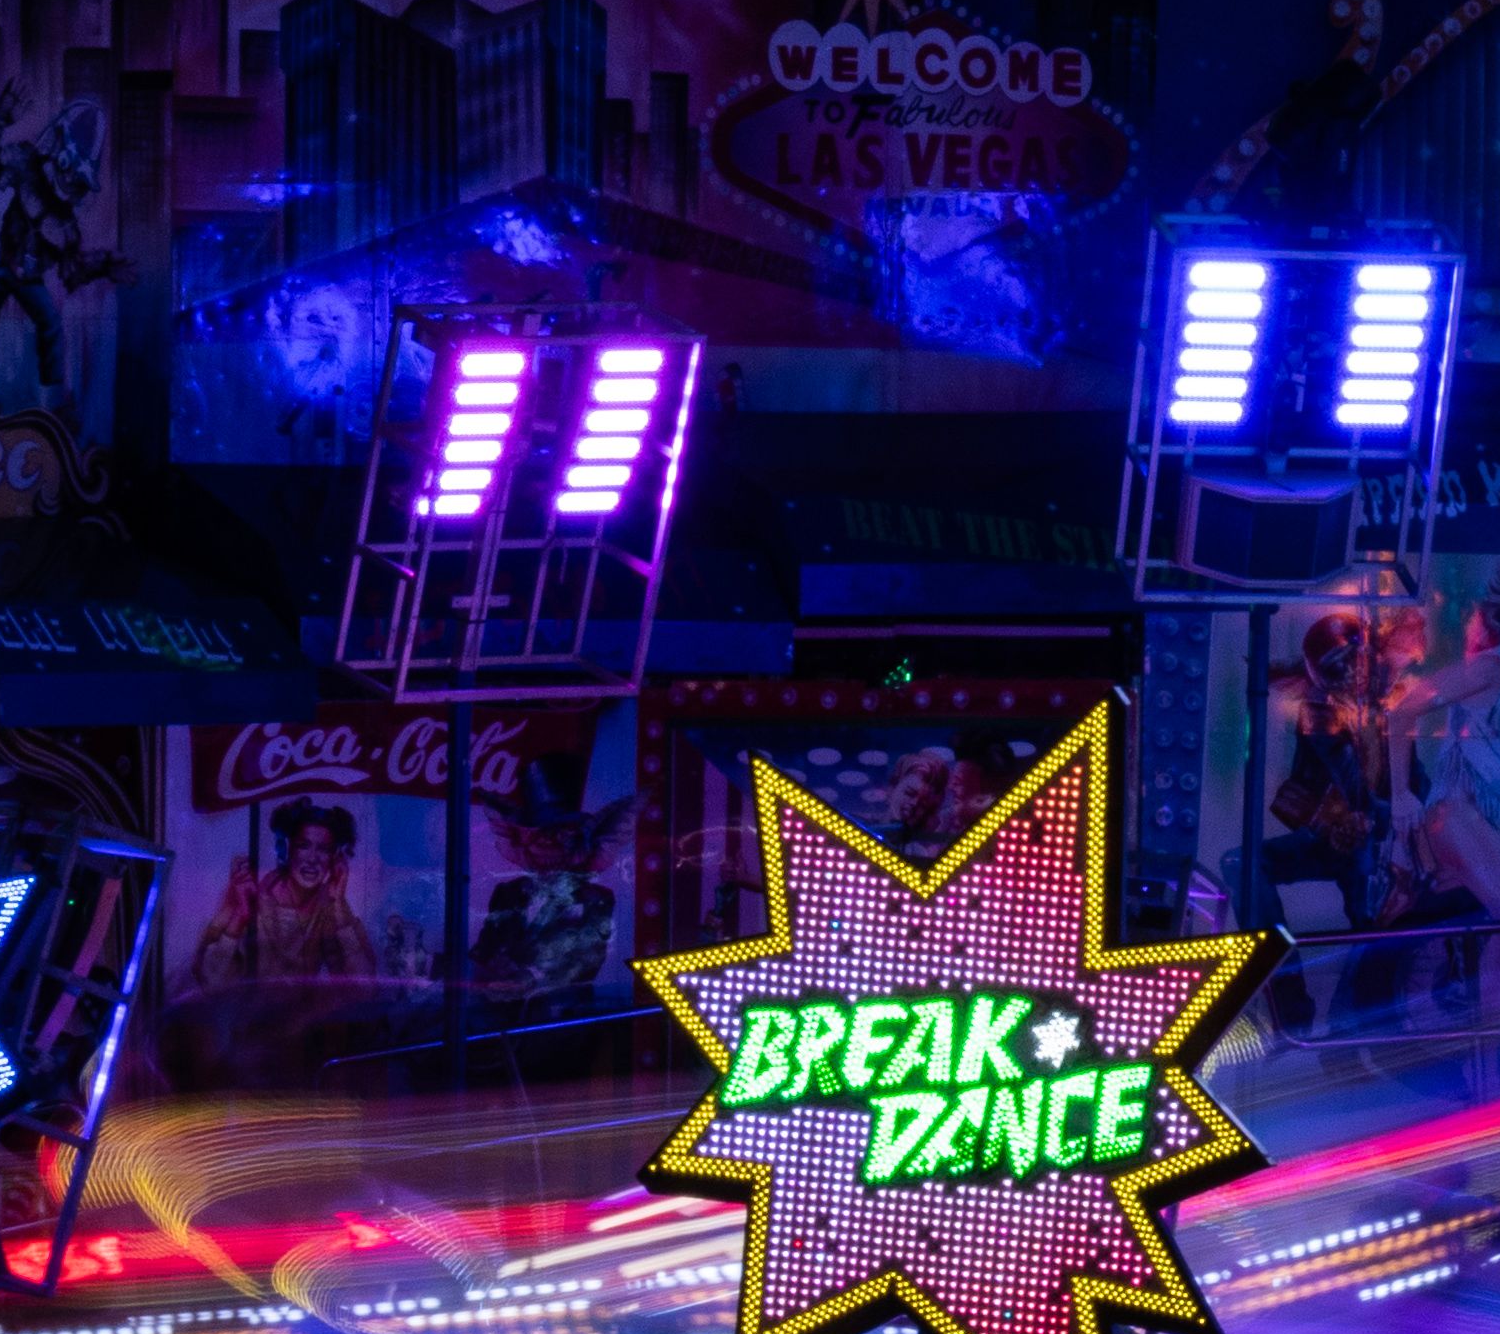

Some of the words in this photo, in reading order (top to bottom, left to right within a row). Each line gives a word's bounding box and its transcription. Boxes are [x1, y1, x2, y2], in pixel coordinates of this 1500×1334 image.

[776, 41, 1084, 98] WELCOME
[803, 99, 844, 125] TO
[846, 93, 1017, 140] Fabulous
[775, 132, 885, 190] LAS
[902, 132, 1083, 191] VEGAS
[841, 497, 945, 551] BEAT
[956, 510, 1045, 563] THE
[719, 993, 1034, 1108] BREAK
[862, 1063, 1155, 1185] DANCE
